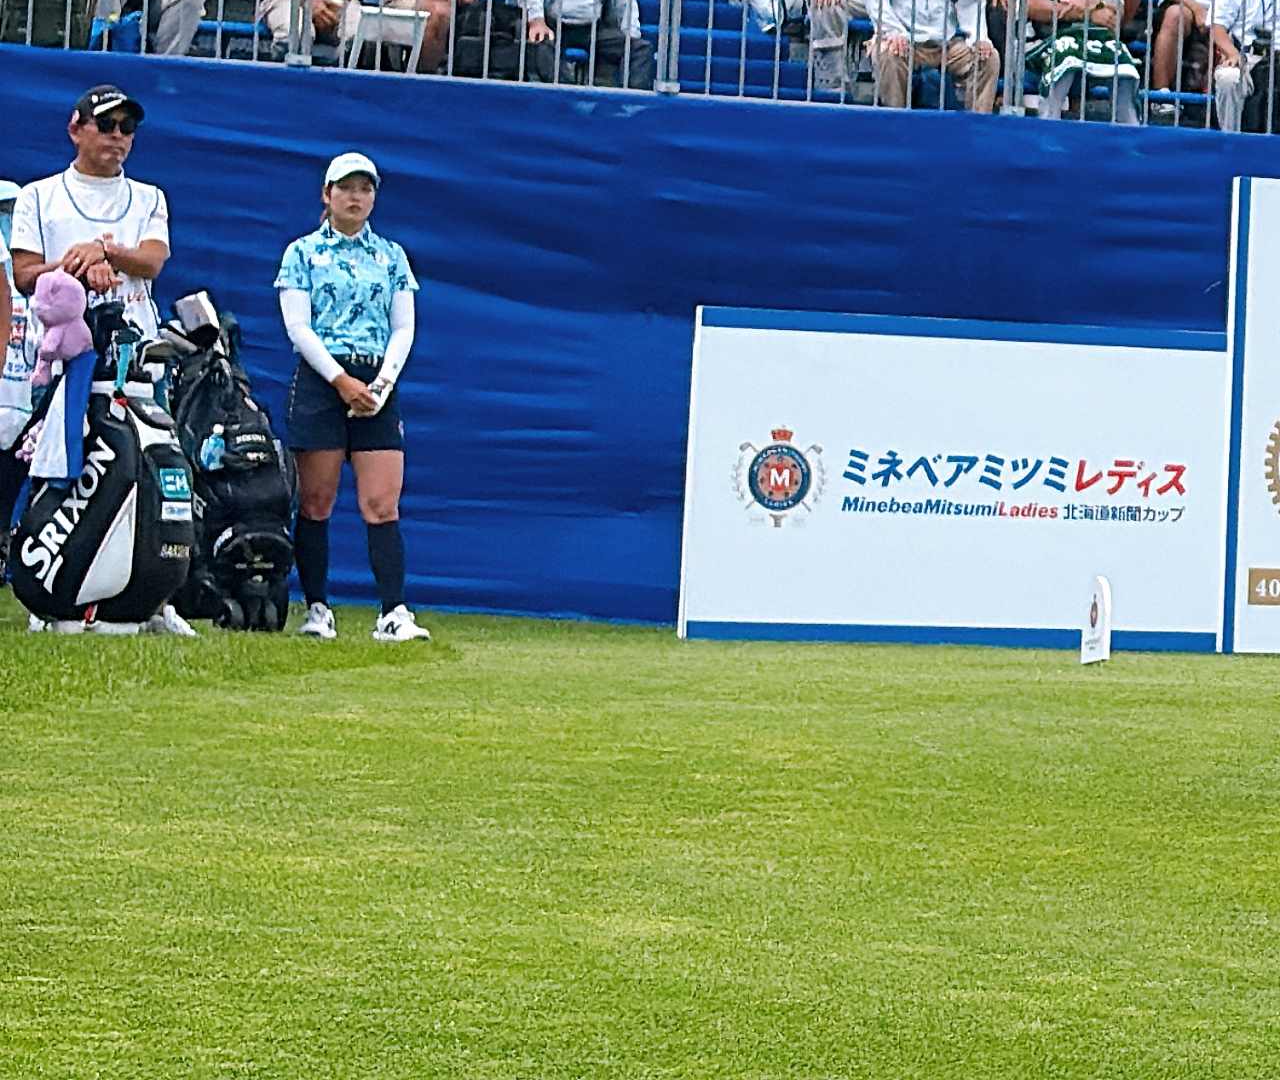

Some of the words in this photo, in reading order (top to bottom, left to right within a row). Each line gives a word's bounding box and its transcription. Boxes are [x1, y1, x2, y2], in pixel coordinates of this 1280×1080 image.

[842, 448, 1187, 498] ミネベアミツミレディス
[20, 435, 116, 593] SRIXON
[1063, 503, 1186, 523] 北海道新聞カップ
